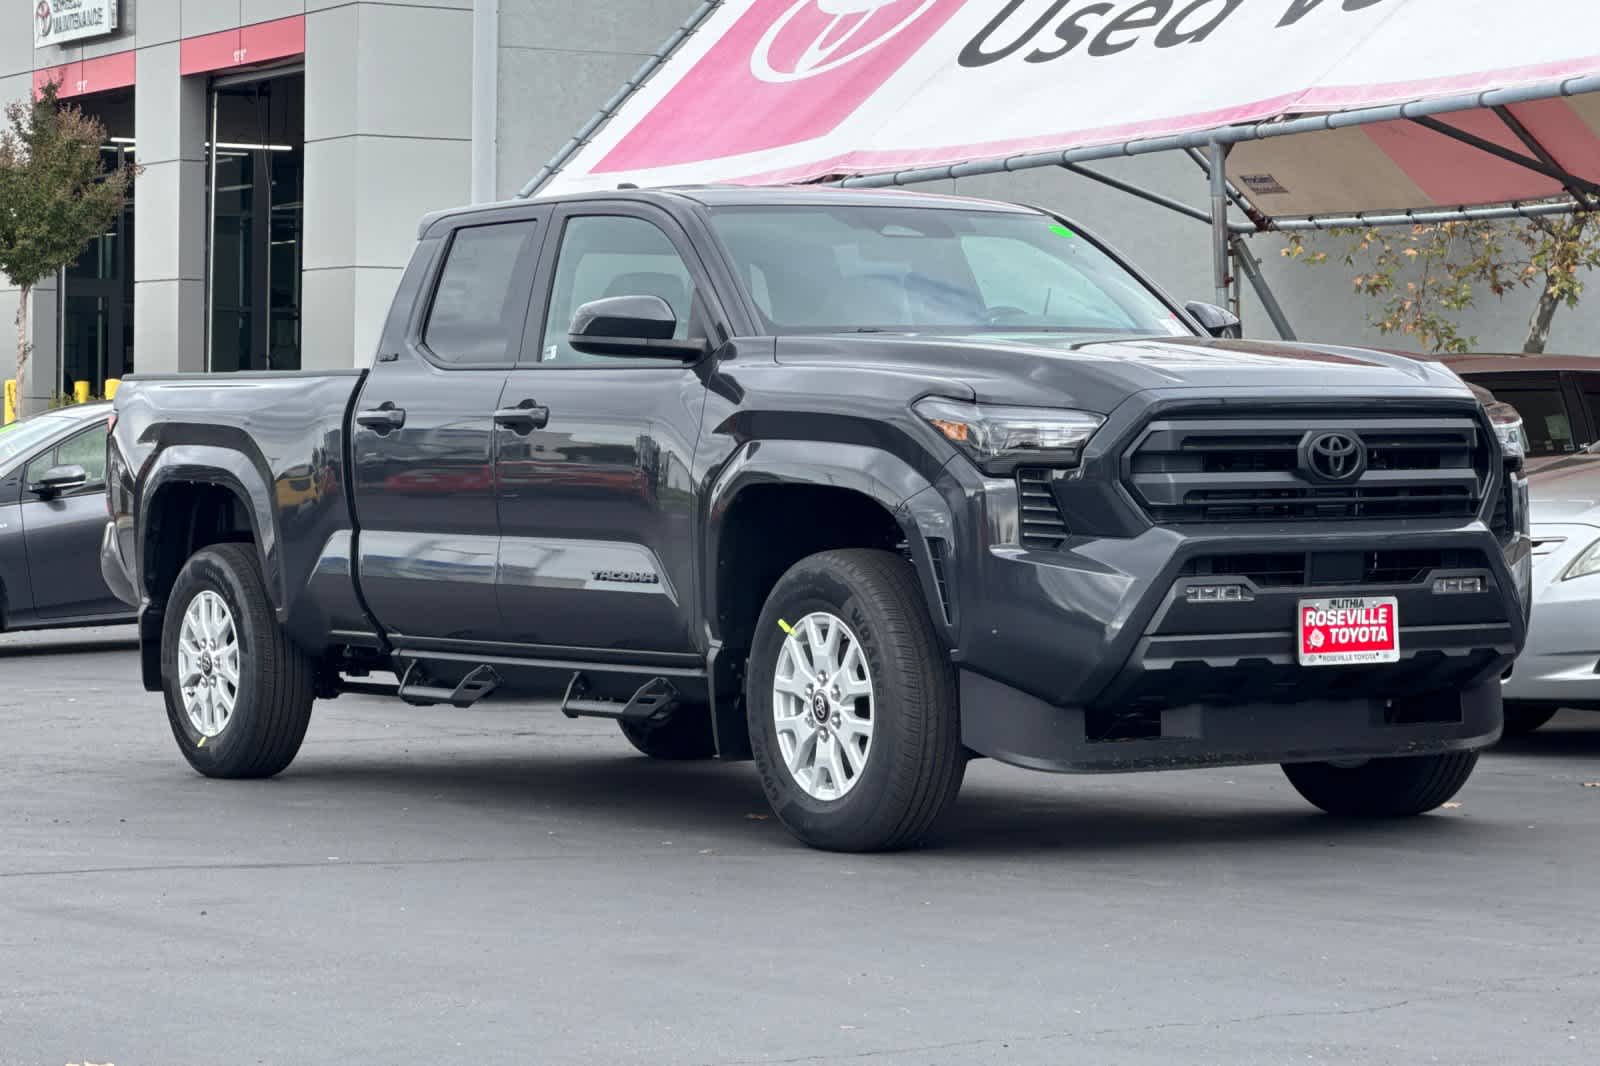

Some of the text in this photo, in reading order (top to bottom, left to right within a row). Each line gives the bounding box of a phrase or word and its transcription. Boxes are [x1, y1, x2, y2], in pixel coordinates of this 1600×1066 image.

[53, 7, 104, 34] MAINTENANCE
[591, 570, 658, 584] TACOMA
[1338, 599, 1365, 608] LITHIA
[1305, 608, 1388, 626] ROSEVILLE
[1329, 627, 1388, 643] TOYOTA
[1322, 653, 1353, 662] ROSEVILLE
